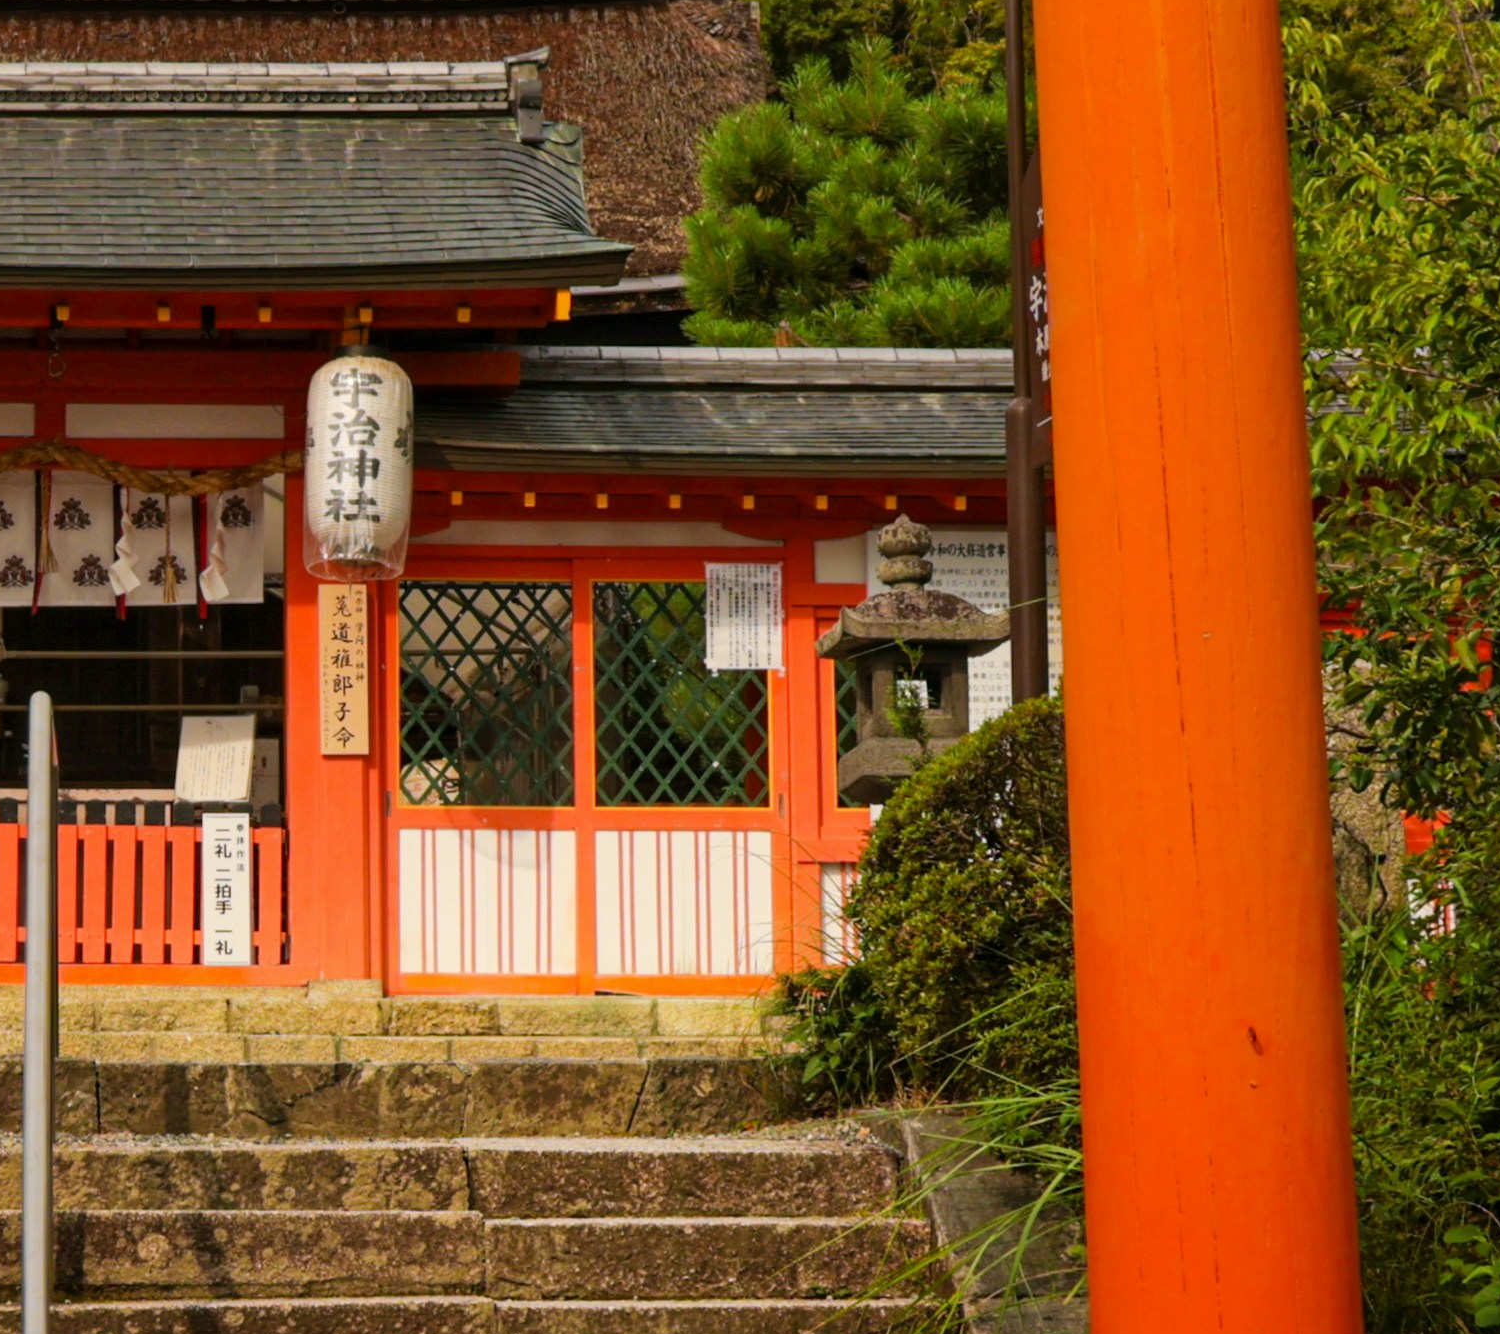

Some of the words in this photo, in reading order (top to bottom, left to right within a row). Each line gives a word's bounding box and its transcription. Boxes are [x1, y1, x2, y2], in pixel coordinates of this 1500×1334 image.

[323, 368, 384, 523] 宇治神社
[214, 828, 233, 859] 二礼
[214, 868, 233, 915] 二拍手
[214, 929, 233, 956] 一礼
